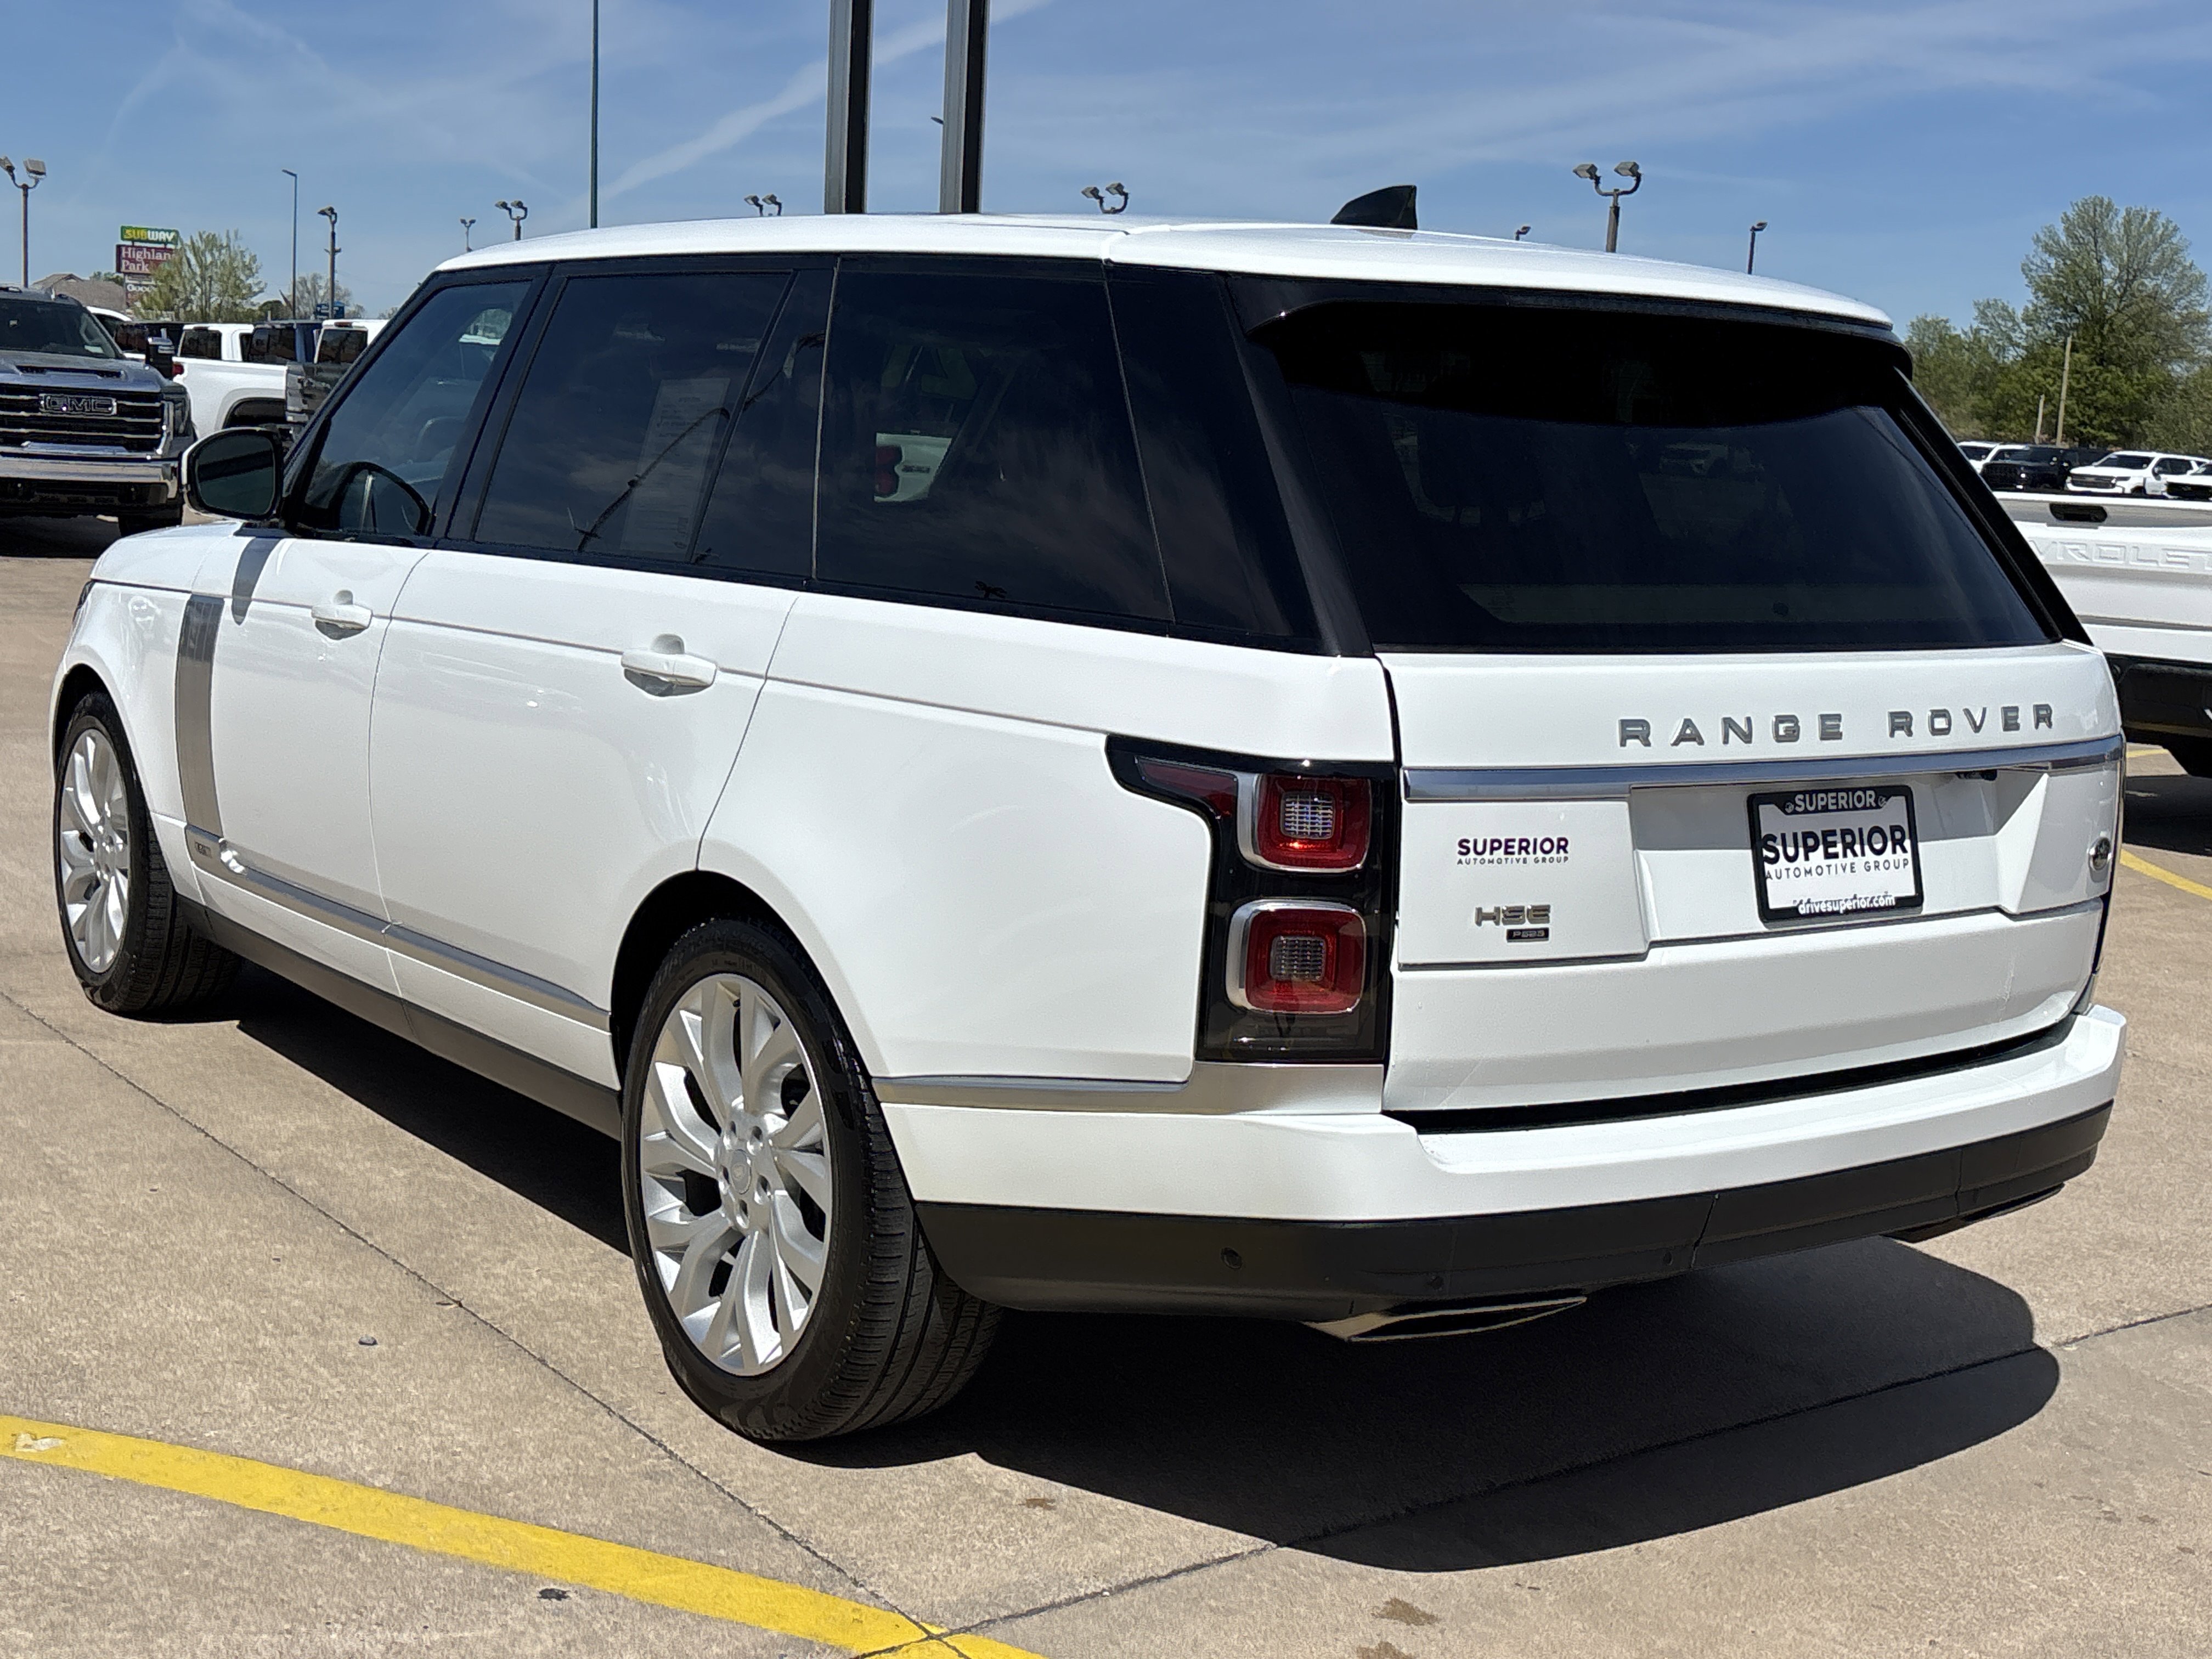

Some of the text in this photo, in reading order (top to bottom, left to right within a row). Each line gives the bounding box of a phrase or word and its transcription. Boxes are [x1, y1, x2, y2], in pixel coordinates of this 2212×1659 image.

[123, 228, 176, 242] SUBWAY
[121, 259, 150, 272] Park
[45, 394, 113, 413] GMC
[1618, 704, 2053, 747] RANGE ROVER
[1794, 790, 1877, 812] SUPERIOR
[1457, 837, 1569, 856] SUPERIOR
[1762, 825, 1909, 865] SUPERIOR
[1765, 858, 1910, 881] AUTOMOTIVE GROUP
[1797, 895, 1896, 915] drivesuperior.com
[1475, 905, 1551, 927] HSE
